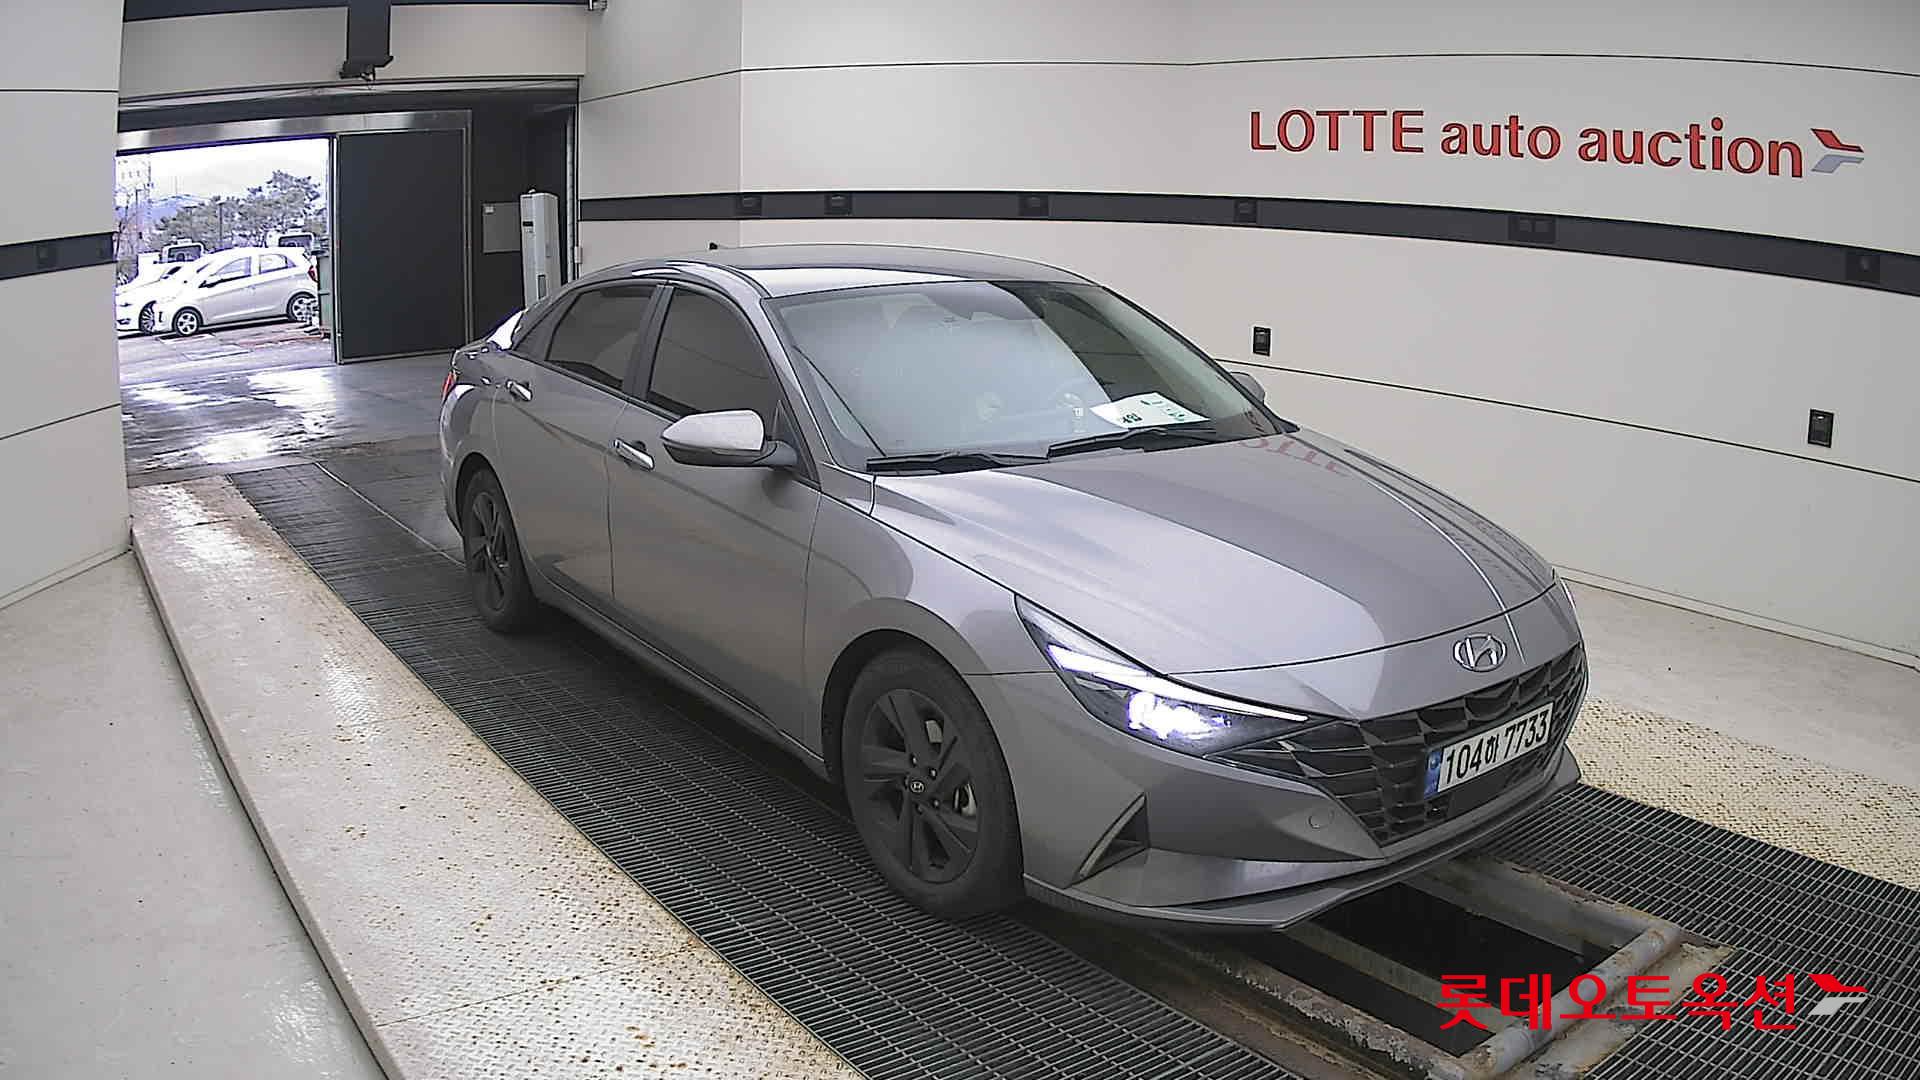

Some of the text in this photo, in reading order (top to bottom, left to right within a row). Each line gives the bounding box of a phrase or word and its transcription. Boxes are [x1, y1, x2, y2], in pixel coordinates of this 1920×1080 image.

[1250, 109, 1804, 178] LOTTE auto auction
[1504, 710, 1549, 757] 7733
